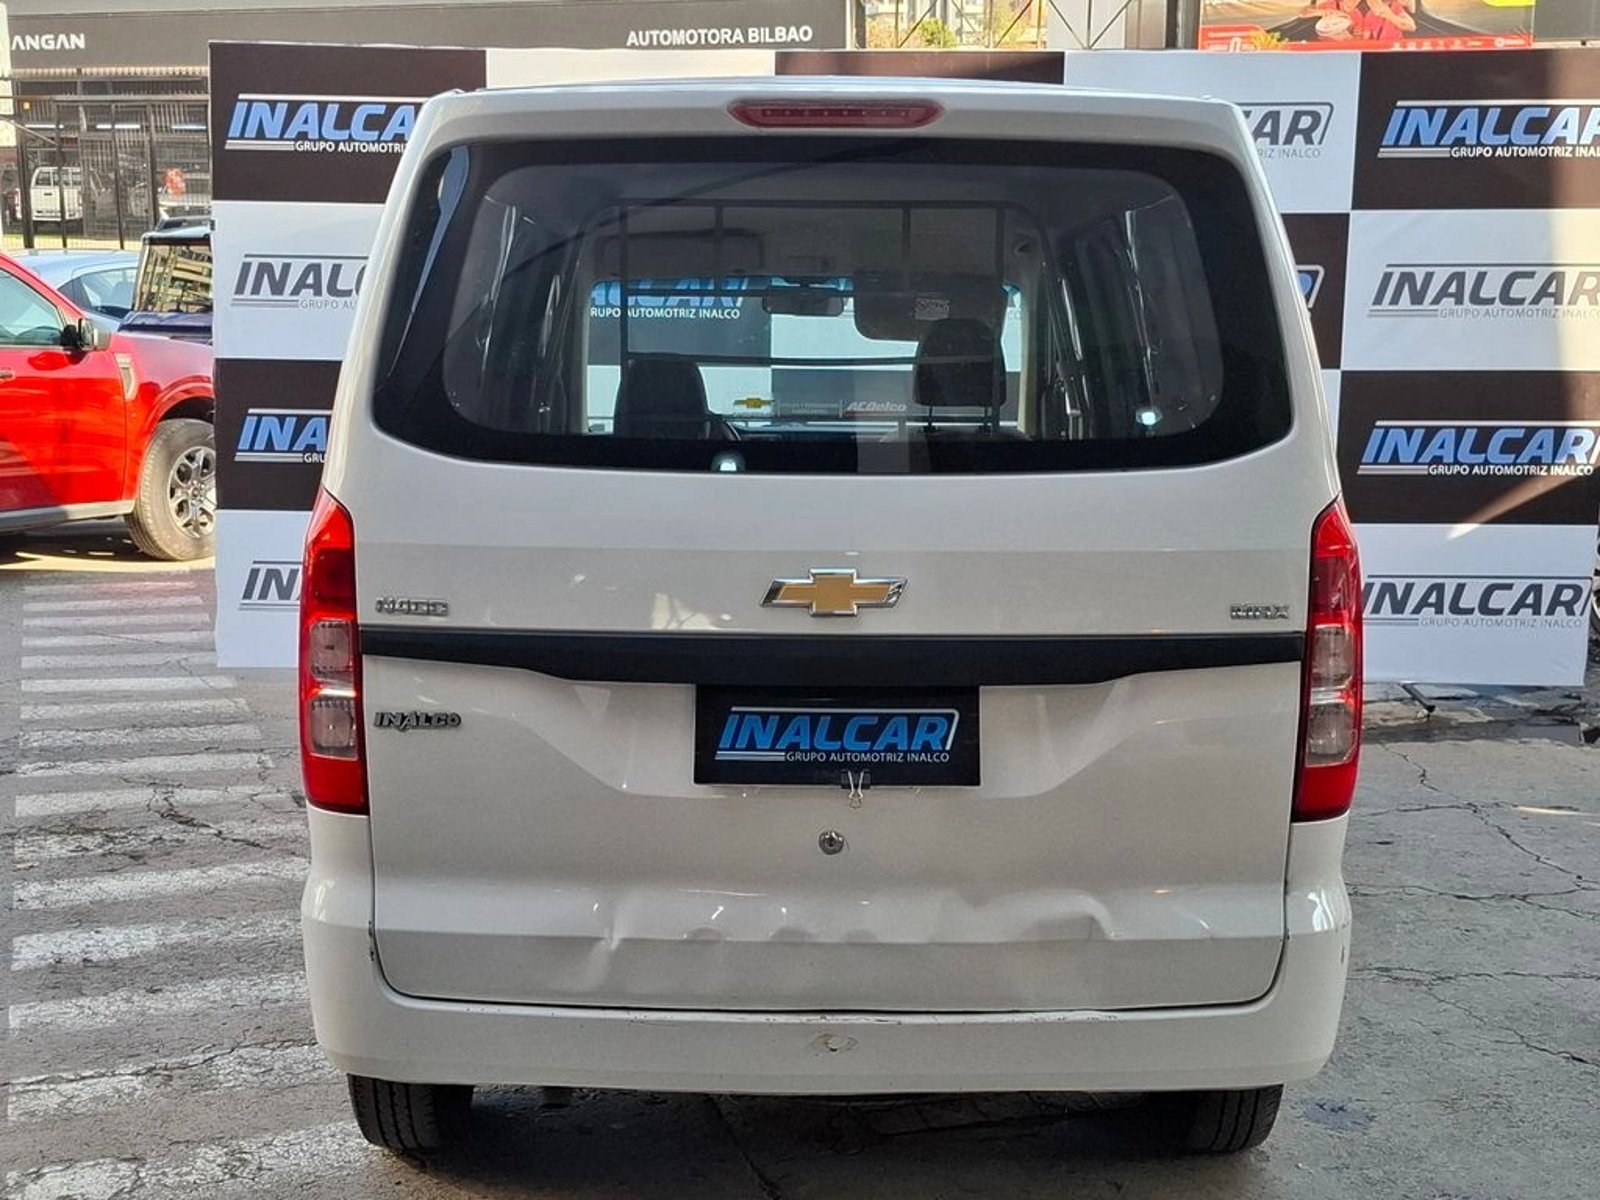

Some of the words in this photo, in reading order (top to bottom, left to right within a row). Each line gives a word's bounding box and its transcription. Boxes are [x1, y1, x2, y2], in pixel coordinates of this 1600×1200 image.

[626, 28, 744, 46] AUTOMOTORA
[748, 26, 813, 43] BILBAO
[1242, 110, 1322, 145] AR
[295, 141, 335, 152] GRUPO
[1451, 147, 1492, 158] GRUPO
[1495, 147, 1573, 158] AUTOMOTRIZ
[234, 261, 366, 298] INAL
[1371, 271, 1600, 306] INALCAR
[301, 300, 338, 310] GRUPO
[699, 309, 740, 319] INALCO
[1440, 308, 1480, 319] GRUPO
[1483, 308, 1559, 319] AUTOMOTRIZ
[1361, 428, 1595, 464] INALCAR
[1429, 465, 1470, 476] GRUPO
[1472, 465, 1548, 476] AUTOMOTRIZ
[1550, 466, 1594, 476] INALCO
[1420, 618, 1459, 628] GRUPO
[1463, 618, 1536, 629] AUTOMOTRIZ
[1539, 619, 1583, 629] INALCO
[374, 711, 462, 731] INALCO
[719, 714, 949, 751] INALCAR
[786, 752, 827, 762] GRUPO
[829, 752, 904, 762] AUTOMOTRIZ
[907, 753, 950, 763] INALCO
